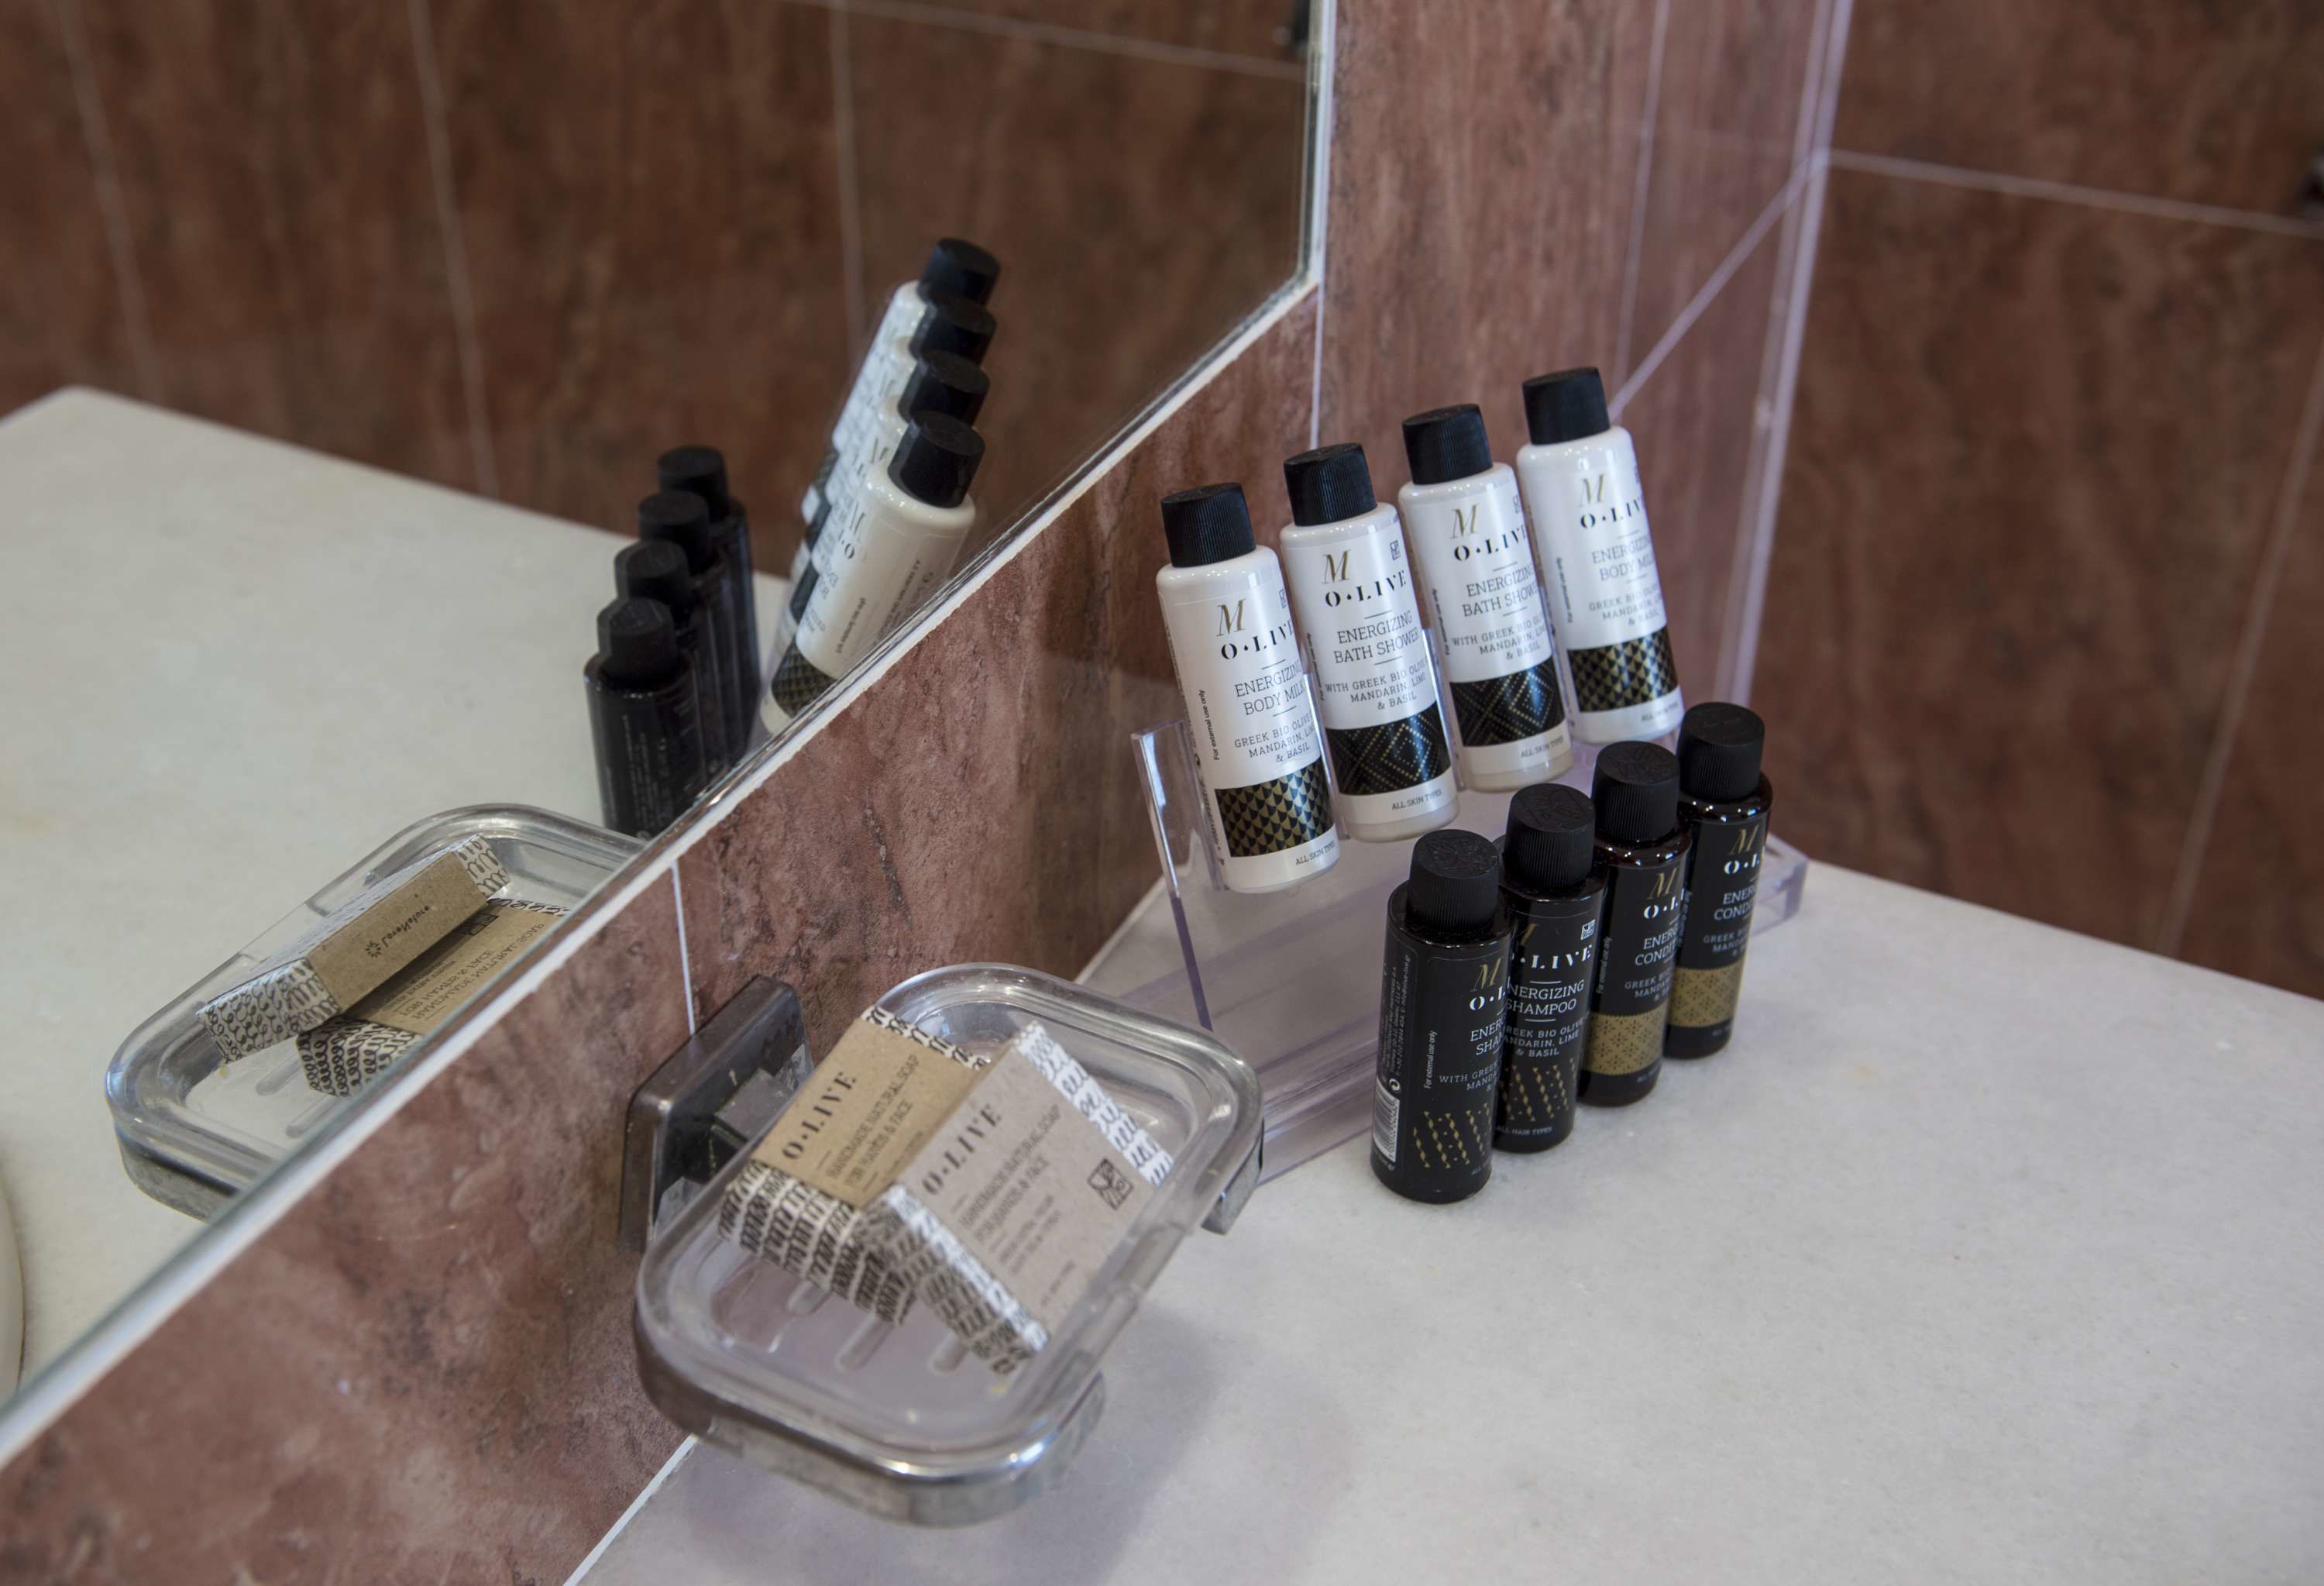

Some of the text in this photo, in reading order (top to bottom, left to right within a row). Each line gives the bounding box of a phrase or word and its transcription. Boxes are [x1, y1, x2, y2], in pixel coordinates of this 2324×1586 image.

[1451, 503, 1480, 539] M
[1322, 549, 1351, 584] M
[1466, 564, 1534, 597] ENERGIZIN
[1215, 598, 1246, 638] M
[1463, 597, 1501, 618] BATH
[1337, 611, 1414, 645] ENERGIZING
[1452, 635, 1478, 647] WITH
[1481, 626, 1515, 644] GREEK
[1333, 628, 1420, 664] BATH SHOWER
[1325, 679, 1349, 693] WITH
[1353, 676, 1387, 691] GREEK
[1391, 669, 1407, 683] BIO
[1243, 693, 1281, 716] BODY
[1377, 691, 1418, 710] & BASIL
[1197, 688, 1220, 761] For external use only
[1234, 732, 1270, 748] GREEK
[1272, 724, 1290, 741] BIO
[1276, 741, 1311, 763] & BASIL
[1391, 800, 1406, 811] ALL
[1407, 796, 1424, 807] SKIN
[1295, 853, 1309, 866] ALL
[1309, 848, 1325, 862] SKIN
[1647, 867, 1678, 900] M
[1470, 956, 1504, 993] M
[1624, 975, 1657, 990] GREEK
[1509, 979, 1585, 1000] NERGIZING
[1503, 1029, 1580, 1048] ANDARIN, LIME
[1504, 1019, 1584, 1039] REEK BIO OLIVE
[1422, 1030, 1438, 1089] For external use only
[1528, 1048, 1559, 1058] BASIL
[1439, 1062, 1498, 1085] WITH GREEK
